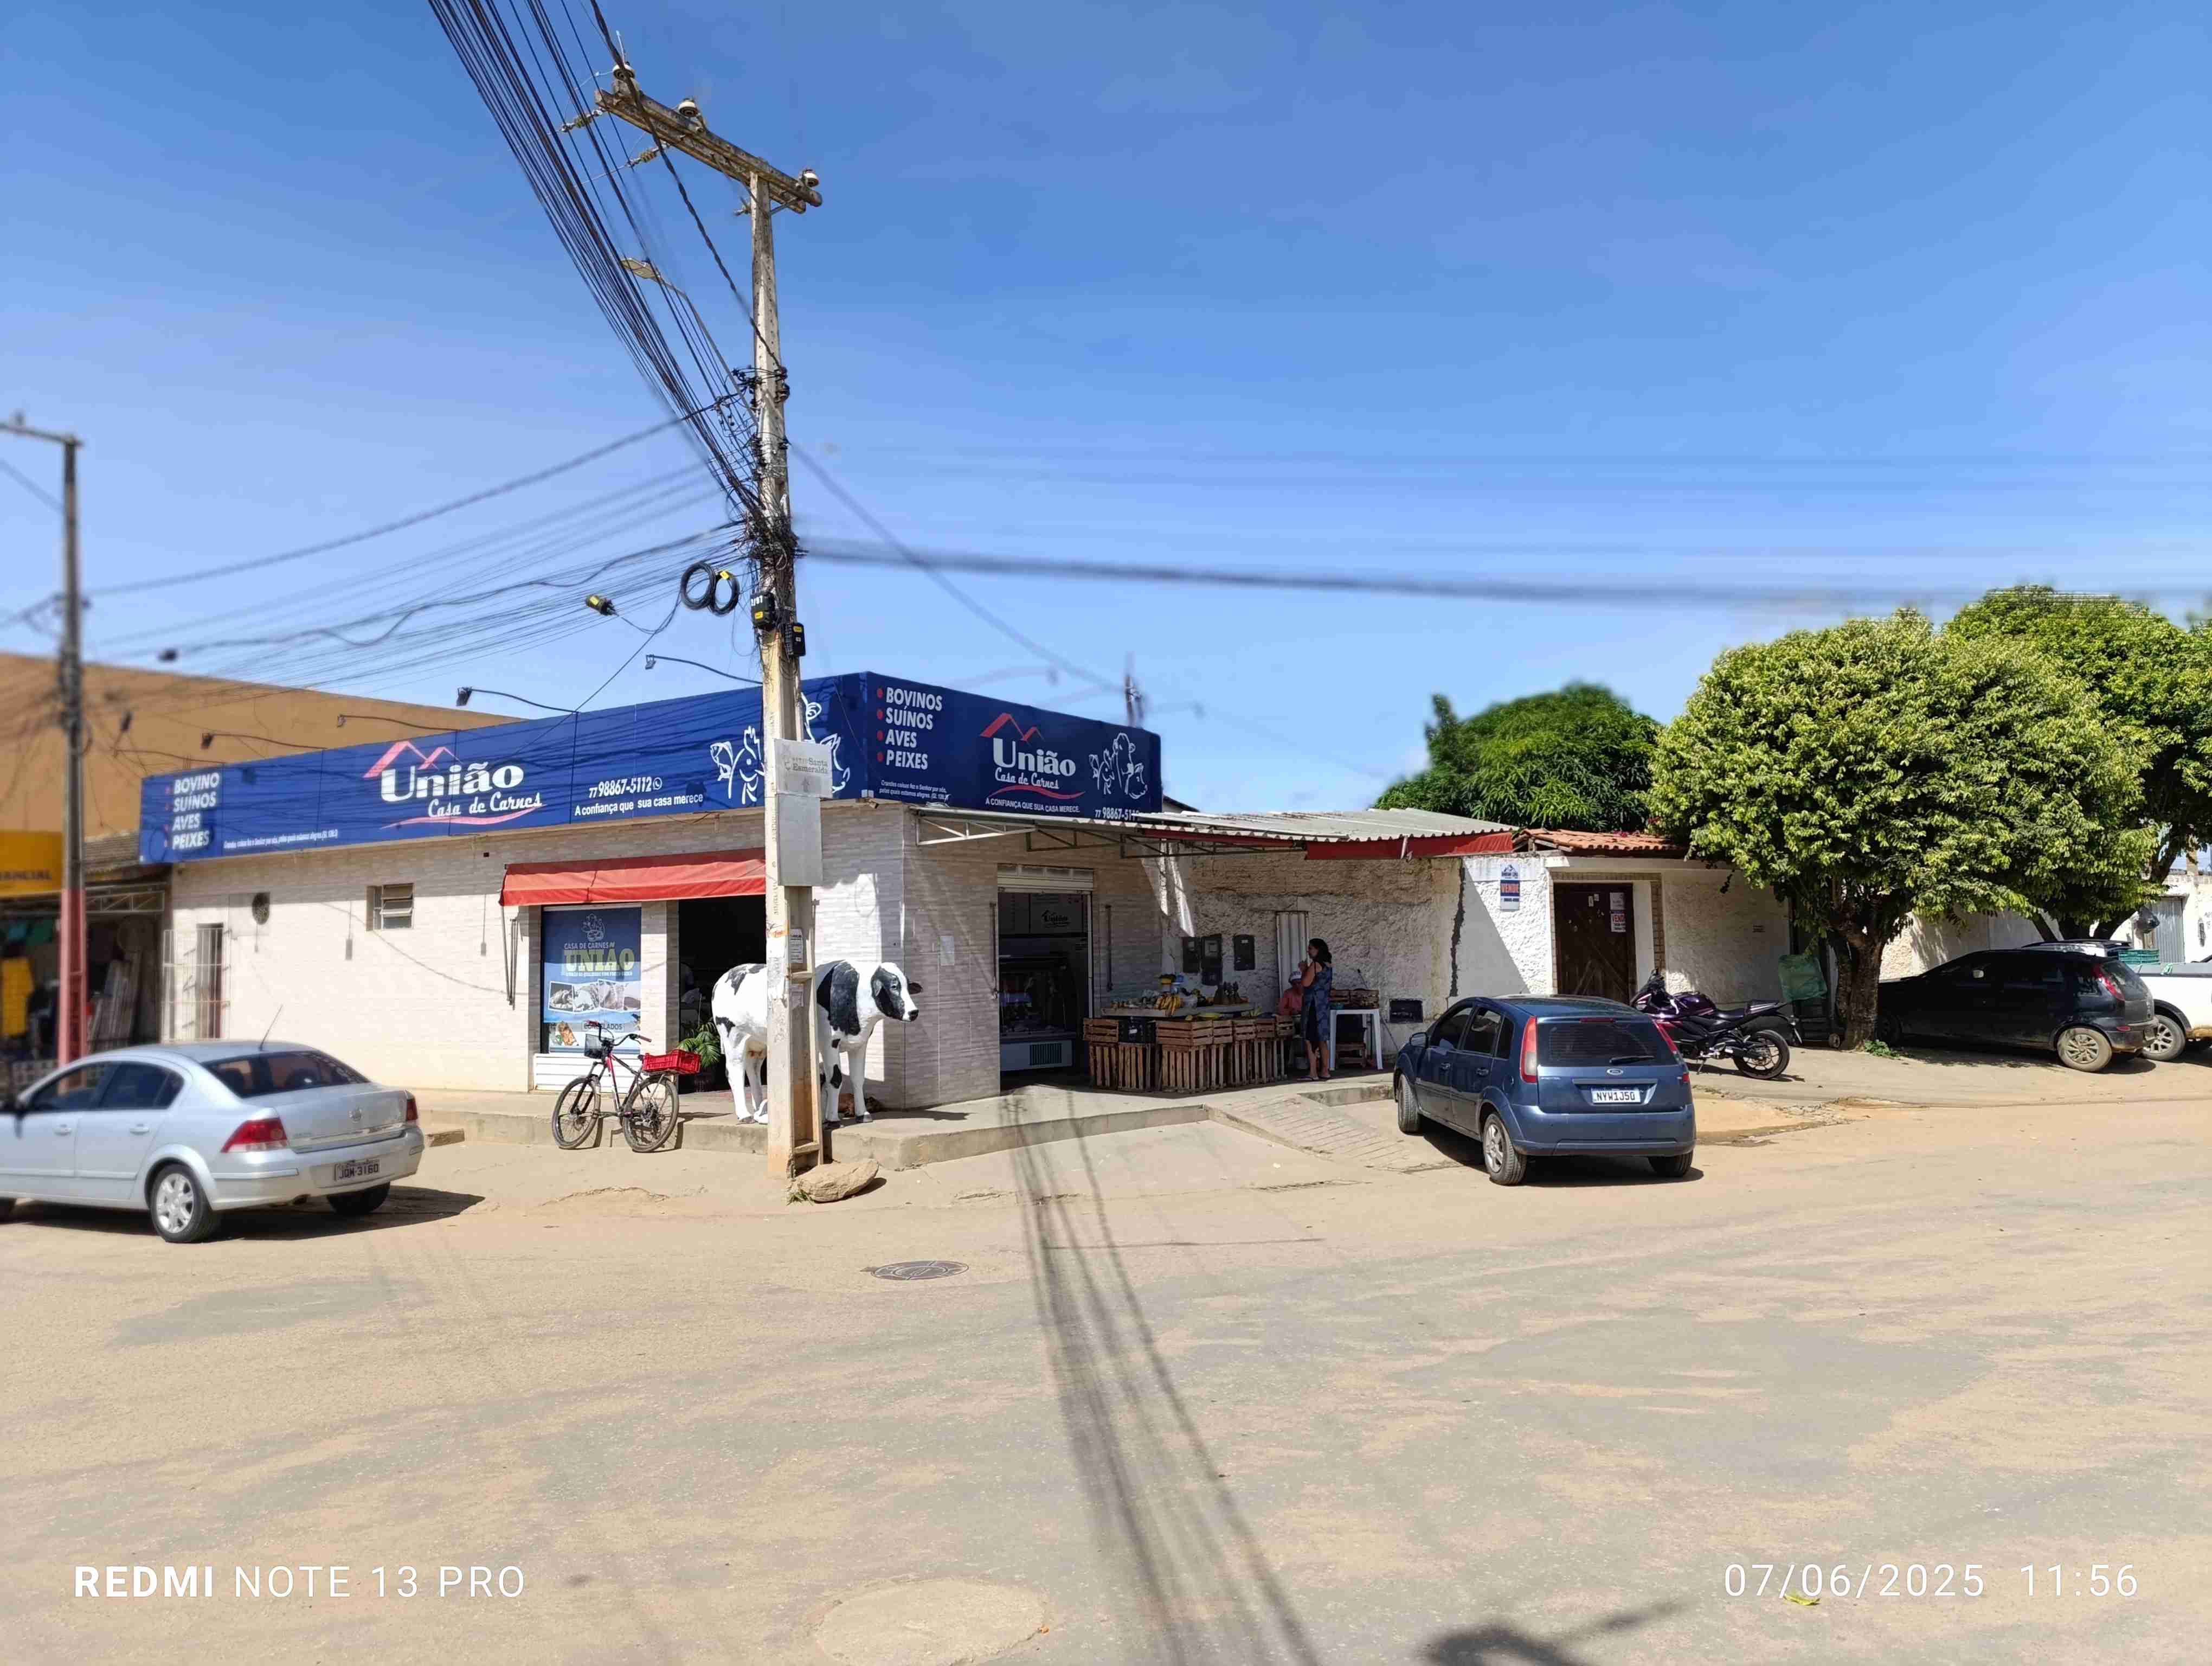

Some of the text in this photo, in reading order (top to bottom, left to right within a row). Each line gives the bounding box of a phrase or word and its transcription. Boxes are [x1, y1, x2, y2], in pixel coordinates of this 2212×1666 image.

[886, 687, 942, 711] BOVINOS
[886, 706, 933, 729] SUÍNOS
[885, 729, 917, 748] AVES
[886, 750, 928, 770] PEIXES
[993, 738, 1076, 776] União
[793, 763, 828, 774] Esmeralda
[995, 767, 1059, 789] Casa de Carnes
[381, 762, 524, 802] União
[598, 777, 652, 797] 98867-5112
[173, 791, 216, 812] SUÍNOS
[428, 791, 542, 817] Casa de Carnes
[575, 793, 703, 816] A confiança que sua casa merece
[991, 798, 1021, 809] CONFIANÇA
[1022, 802, 1033, 810] QUE
[172, 813, 201, 831] AVES
[1095, 810, 1101, 818] 77
[172, 830, 210, 850] PEIXES
